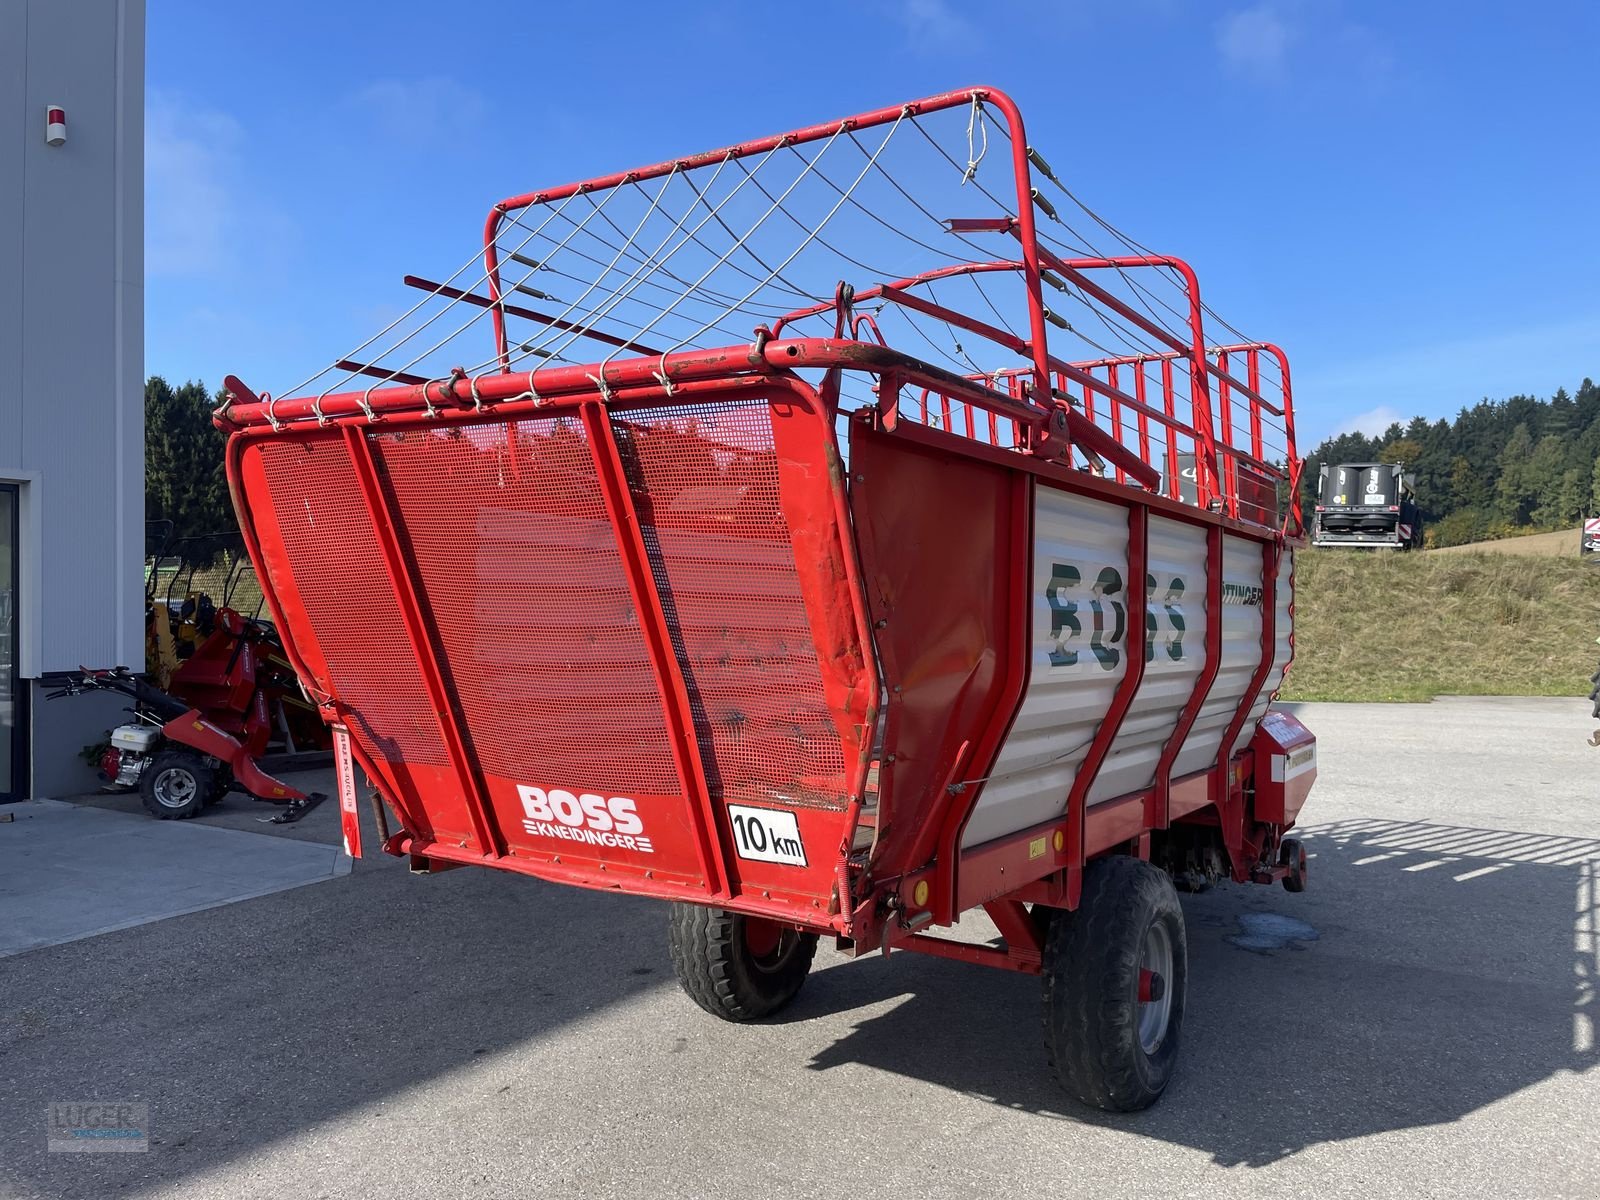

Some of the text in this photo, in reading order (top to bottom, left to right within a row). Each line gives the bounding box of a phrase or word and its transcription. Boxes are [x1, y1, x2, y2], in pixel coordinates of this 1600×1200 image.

[516, 784, 643, 834] BOSS
[537, 822, 636, 851] KNEIDINGER
[734, 814, 802, 858] 10 km
